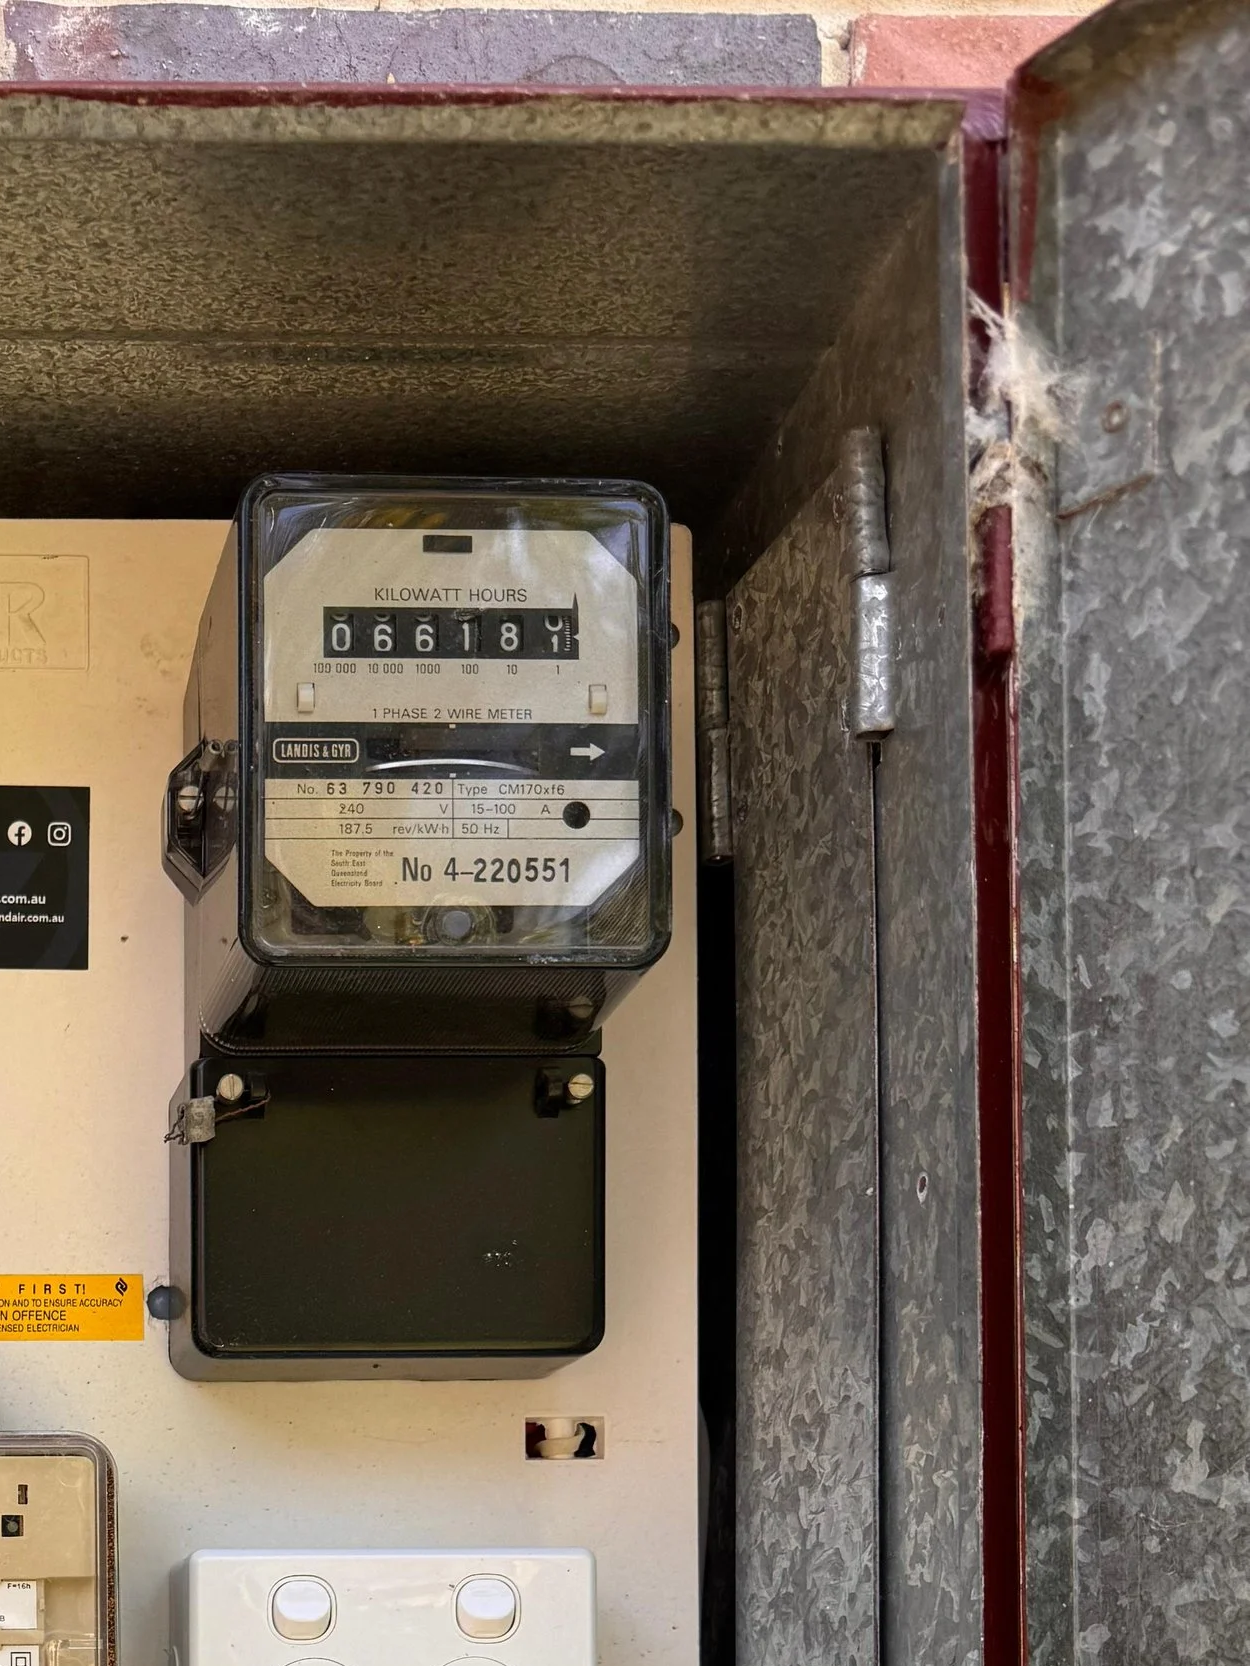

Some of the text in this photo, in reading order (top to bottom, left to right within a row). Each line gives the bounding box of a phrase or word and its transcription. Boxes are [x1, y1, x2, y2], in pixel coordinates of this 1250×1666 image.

[375, 588, 527, 602] KILOWATT HOURS
[384, 708, 427, 719] PHASE
[434, 708, 441, 719] 2
[447, 709, 482, 719] WIRE
[488, 709, 532, 719] METER
[280, 744, 351, 758] LANDIS & GYR
[297, 782, 442, 795] No. 63 790 420
[403, 857, 569, 883] No 4-220551
[19, 1284, 85, 1294] FIRST!
[12, 1299, 29, 1307] AND
[32, 1299, 41, 1307] TO
[44, 1299, 77, 1307] ENSURE
[79, 1299, 123, 1307] ACCURACY
[12, 1310, 66, 1321] OFFENCE
[27, 1324, 79, 1332] ELECTRICIAN
